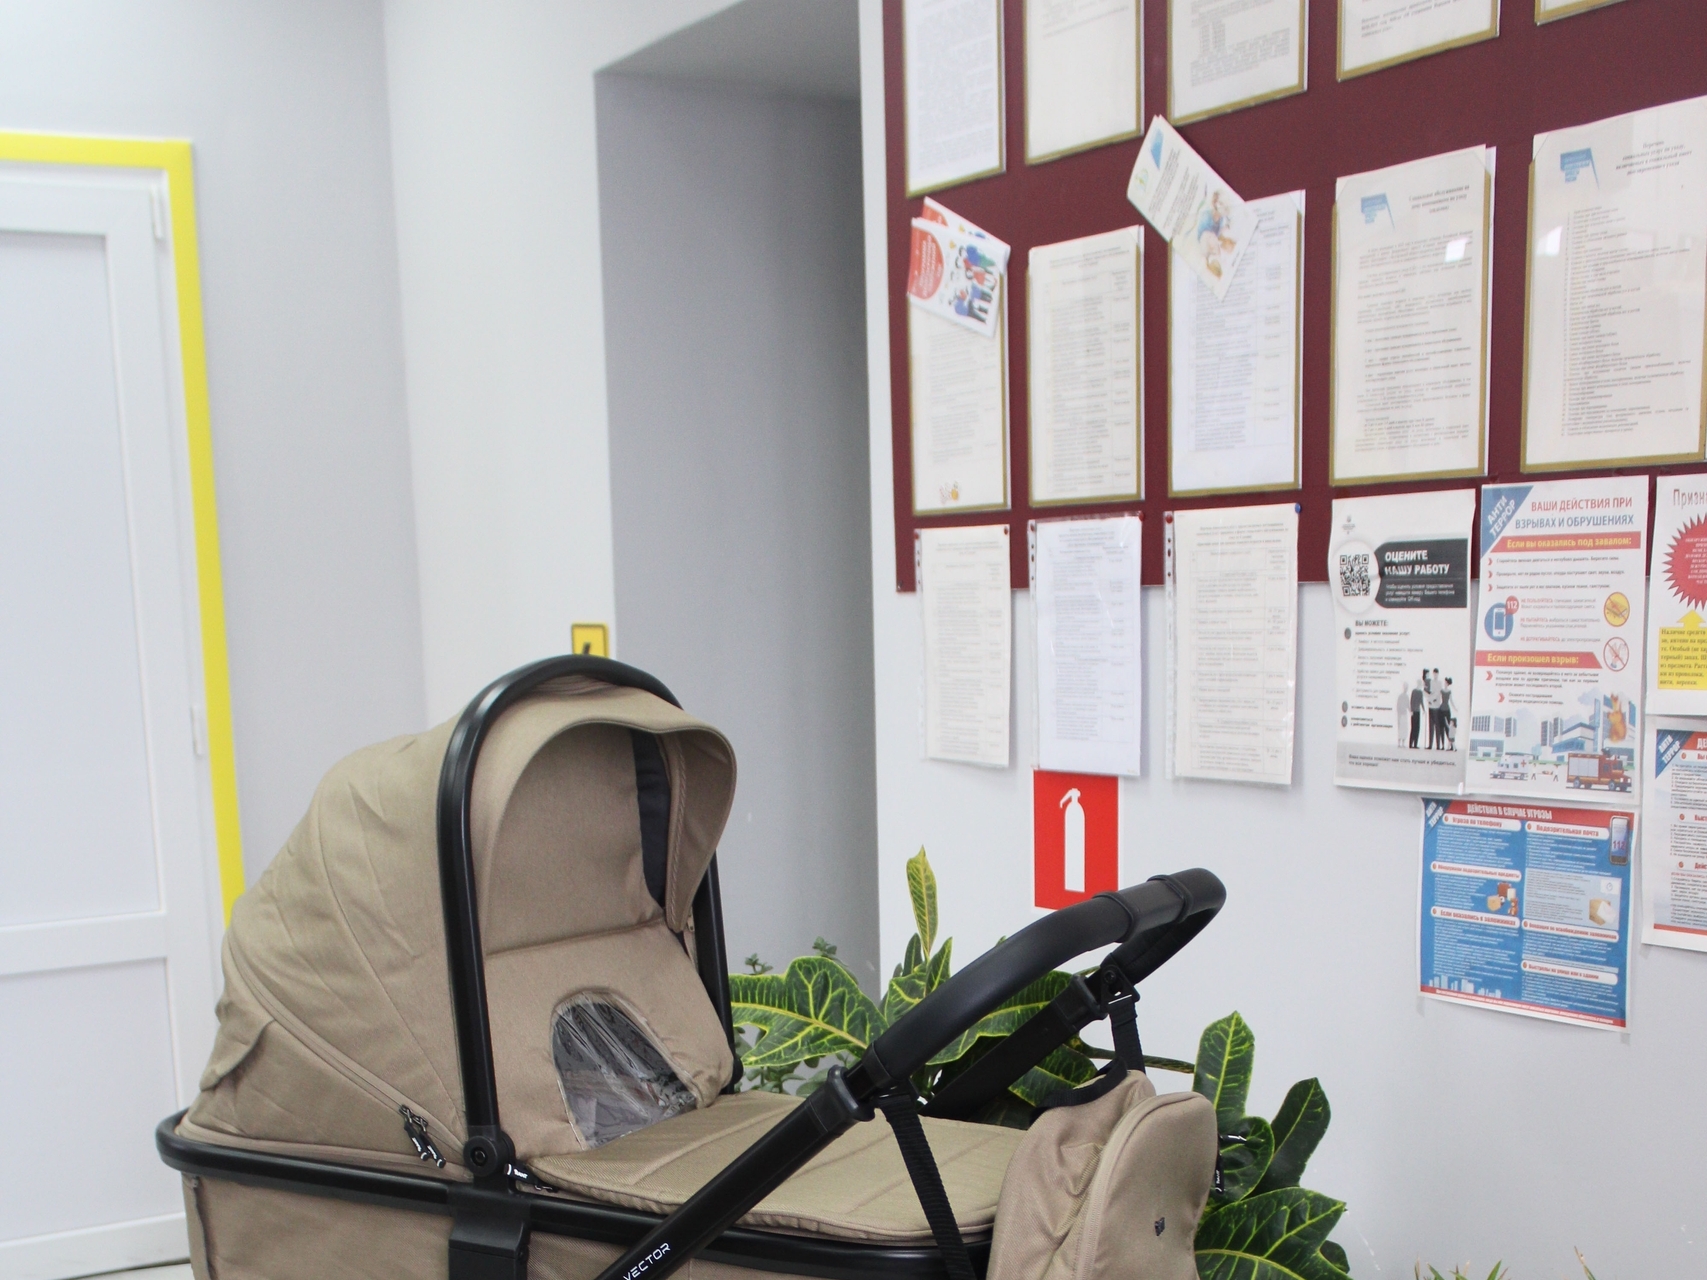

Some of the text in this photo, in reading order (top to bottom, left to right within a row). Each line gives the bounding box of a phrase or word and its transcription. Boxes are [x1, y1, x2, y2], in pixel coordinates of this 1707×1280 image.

[1487, 495, 1507, 524] АНТИ
[1531, 497, 1632, 512] ВАШИ ДЕЙСТВИЯ ПРИ
[1489, 499, 1516, 538] ТЕРРОР
[1515, 514, 1634, 529] ВЗРЫВАХ И ОБРУШЕНИЯХ
[1507, 539, 1525, 548] Если
[1538, 539, 1576, 547] оказались
[1578, 540, 1593, 548] под
[1595, 538, 1632, 546] завалом:
[1384, 549, 1428, 562] ОЦЕНИТЕ
[1384, 563, 1450, 575] НАШУ РАБОТУ
[1506, 600, 1518, 609] 112
[1364, 619, 1389, 627] МОЖЕТЕ:
[1487, 653, 1579, 665] Если произошел взрыв:
[1467, 803, 1553, 820] ДЕЙСТВИЯ В СЛУЧАЕ УГРОЗЫ
[1477, 818, 1502, 828] телефону
[1536, 824, 1599, 837] Подозрительная почта
[1612, 840, 1626, 850] 112
